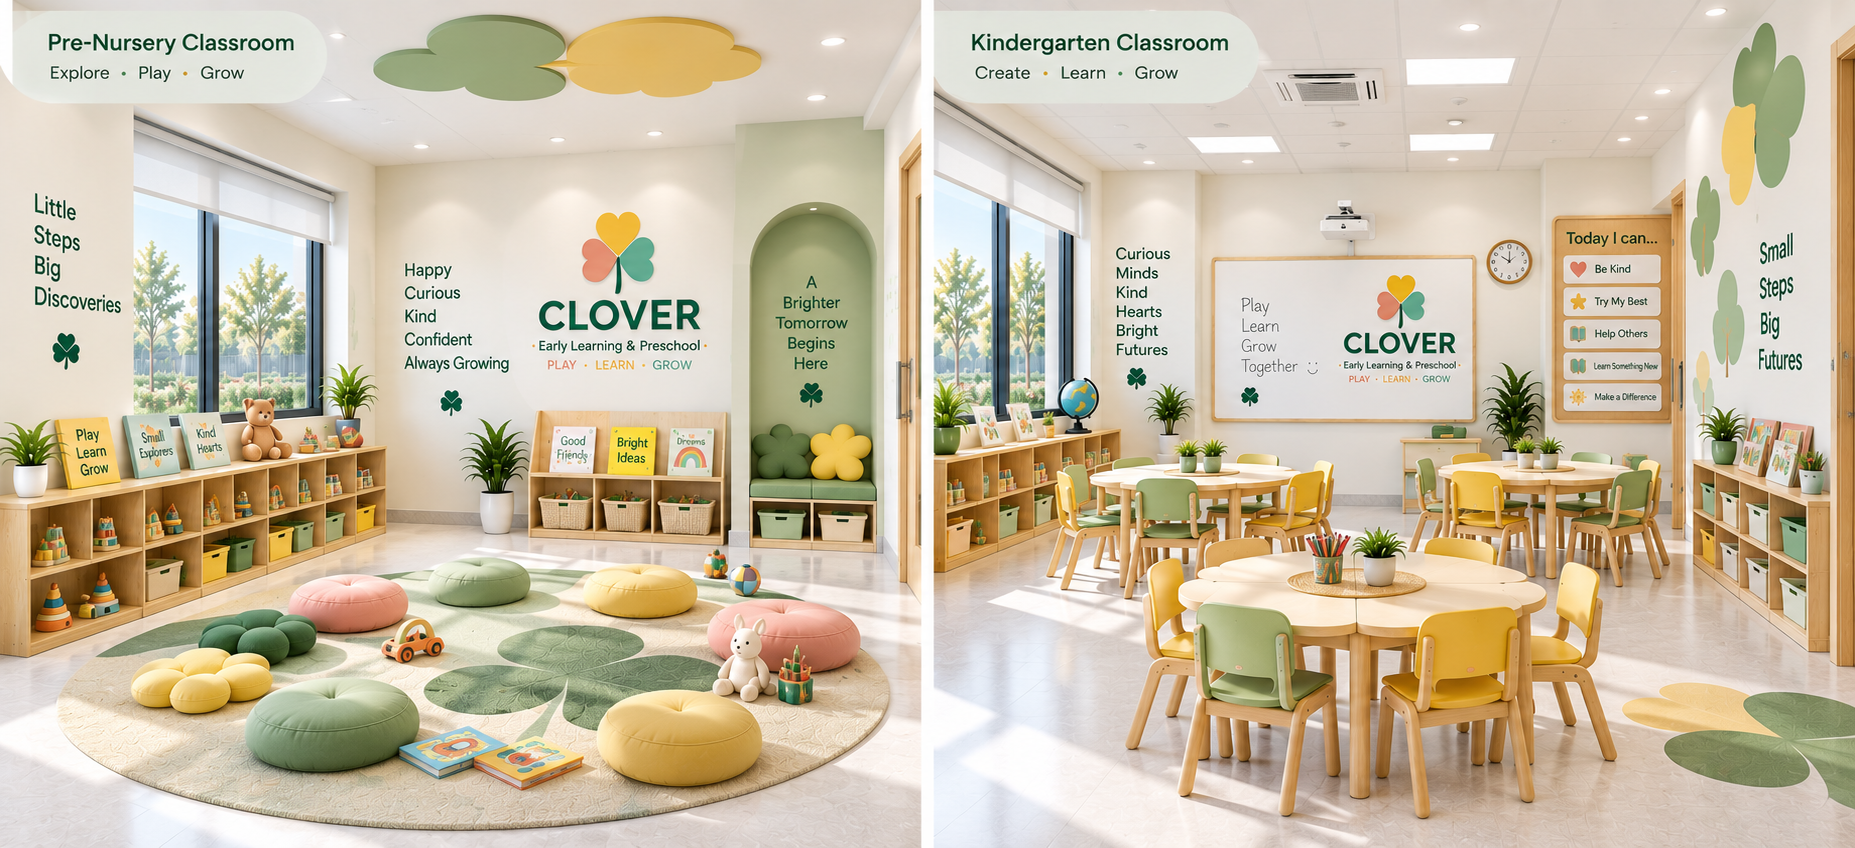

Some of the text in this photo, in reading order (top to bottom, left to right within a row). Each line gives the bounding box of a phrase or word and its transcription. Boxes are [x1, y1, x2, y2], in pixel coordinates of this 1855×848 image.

[35, 193, 76, 220] Little
[34, 225, 80, 253] Steps
[1566, 232, 1609, 247] Today
[1614, 232, 1616, 244] I
[1116, 247, 1170, 260] Curious
[1760, 233, 1793, 264] Small
[35, 255, 60, 282] Big
[405, 263, 452, 279] Happy
[1117, 267, 1158, 279] Minds
[1595, 264, 1630, 273] Be Kind
[806, 276, 817, 288] A
[1760, 277, 1793, 301] Steps
[405, 286, 460, 300] Curious
[1117, 286, 1147, 298] Kind
[35, 286, 121, 313] Discoveries
[784, 296, 840, 312] Brighter
[1595, 297, 1647, 307] Try My Best
[1117, 305, 1162, 317] Hearts
[1241, 298, 1269, 317] Play
[405, 309, 436, 323] Kind
[539, 299, 700, 331] CLOVER
[775, 317, 848, 329] Tomorrow
[1242, 318, 1279, 332] Learn
[1761, 311, 1779, 339] Big
[1117, 324, 1158, 339] Bright
[1595, 329, 1648, 340] Help Others
[405, 332, 472, 346] Confident
[788, 337, 835, 352] Begins
[1242, 339, 1277, 352] Grow
[1344, 332, 1455, 354] CLOVER
[539, 340, 700, 354] Early Learning & Preschool
[1117, 343, 1168, 355] Futures
[404, 356, 509, 373] Always Growing
[548, 360, 692, 370] PLAY LEARN GROW
[795, 357, 828, 369] Here
[1344, 361, 1456, 371] Early Learning & Preschool
[1759, 349, 1802, 370] Futures
[1241, 359, 1298, 377] Together
[1383, 375, 1410, 383] LEARN
[1423, 375, 1450, 383] GROW
[76, 428, 99, 443] Play
[561, 436, 586, 446] Good
[617, 437, 648, 450] Bright
[76, 448, 107, 459] Learn
[618, 452, 645, 463] Ideas
[81, 464, 108, 476] Grow
